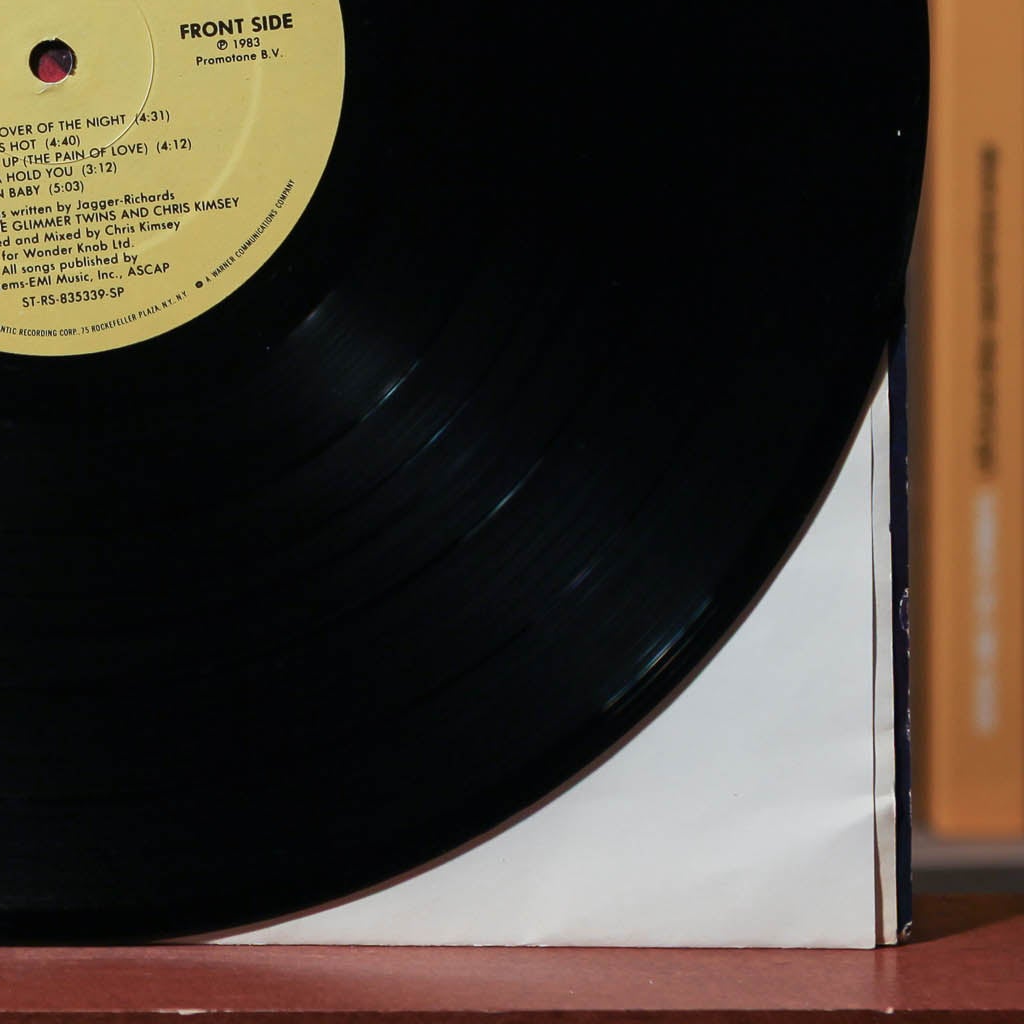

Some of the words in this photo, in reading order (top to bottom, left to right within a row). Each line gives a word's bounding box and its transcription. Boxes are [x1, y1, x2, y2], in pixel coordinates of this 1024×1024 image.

[180, 18, 244, 40] FRONT
[252, 13, 294, 32] SIDE
[233, 37, 260, 49] 1983
[196, 53, 256, 66] Promotone
[261, 48, 284, 60] B.V.
[36, 122, 54, 134] OF
[58, 118, 82, 132] THE
[86, 114, 126, 128] NIGHT
[134, 110, 170, 126] (4:31)
[2, 156, 20, 168] UP
[23, 152, 50, 167] (THE
[55, 149, 85, 164] PAIN
[89, 147, 108, 159] OF
[111, 142, 148, 157] LOVE)
[156, 138, 192, 154] (4:12)
[10, 139, 37, 152] HOT
[45, 135, 81, 150] (4:40)
[6, 170, 42, 183] HOLD
[46, 166, 73, 178] YOU
[82, 162, 117, 178] (3:12)
[9, 185, 40, 198] BABY
[48, 180, 84, 196] (5:03)
[10, 203, 52, 218] written
[56, 202, 72, 214] by
[76, 190, 175, 212] Jagger-Richards
[12, 215, 72, 232] GLIMMER
[75, 210, 116, 225] TWINS
[121, 206, 149, 220] AND
[154, 203, 190, 217] CHRIS
[194, 196, 240, 212] KIMSEY
[16, 234, 40, 246] and
[44, 227, 81, 242] Mixed
[86, 227, 101, 240] by
[105, 222, 136, 236] Chris
[140, 220, 180, 232] Kimsey
[2, 250, 19, 261] for
[24, 244, 72, 259] Wonder
[78, 240, 108, 254] Knob
[112, 238, 134, 250] Ltd.
[19, 328, 58, 337] RECORDING
[82, 325, 90, 334] 75
[92, 313, 136, 333] ROCKEFELLER
[212, 256, 236, 278] WARNER
[234, 208, 278, 258] COMMUNICATIONS
[274, 178, 296, 209] COMPANY
[2, 264, 17, 276] All
[22, 262, 56, 274] songs
[60, 254, 118, 272] published
[123, 252, 138, 264] by
[56, 273, 93, 285] Music,
[98, 270, 123, 280] Inc.,
[128, 262, 170, 277] ASCAP
[22, 287, 125, 308] ST-RS-835339-SP
